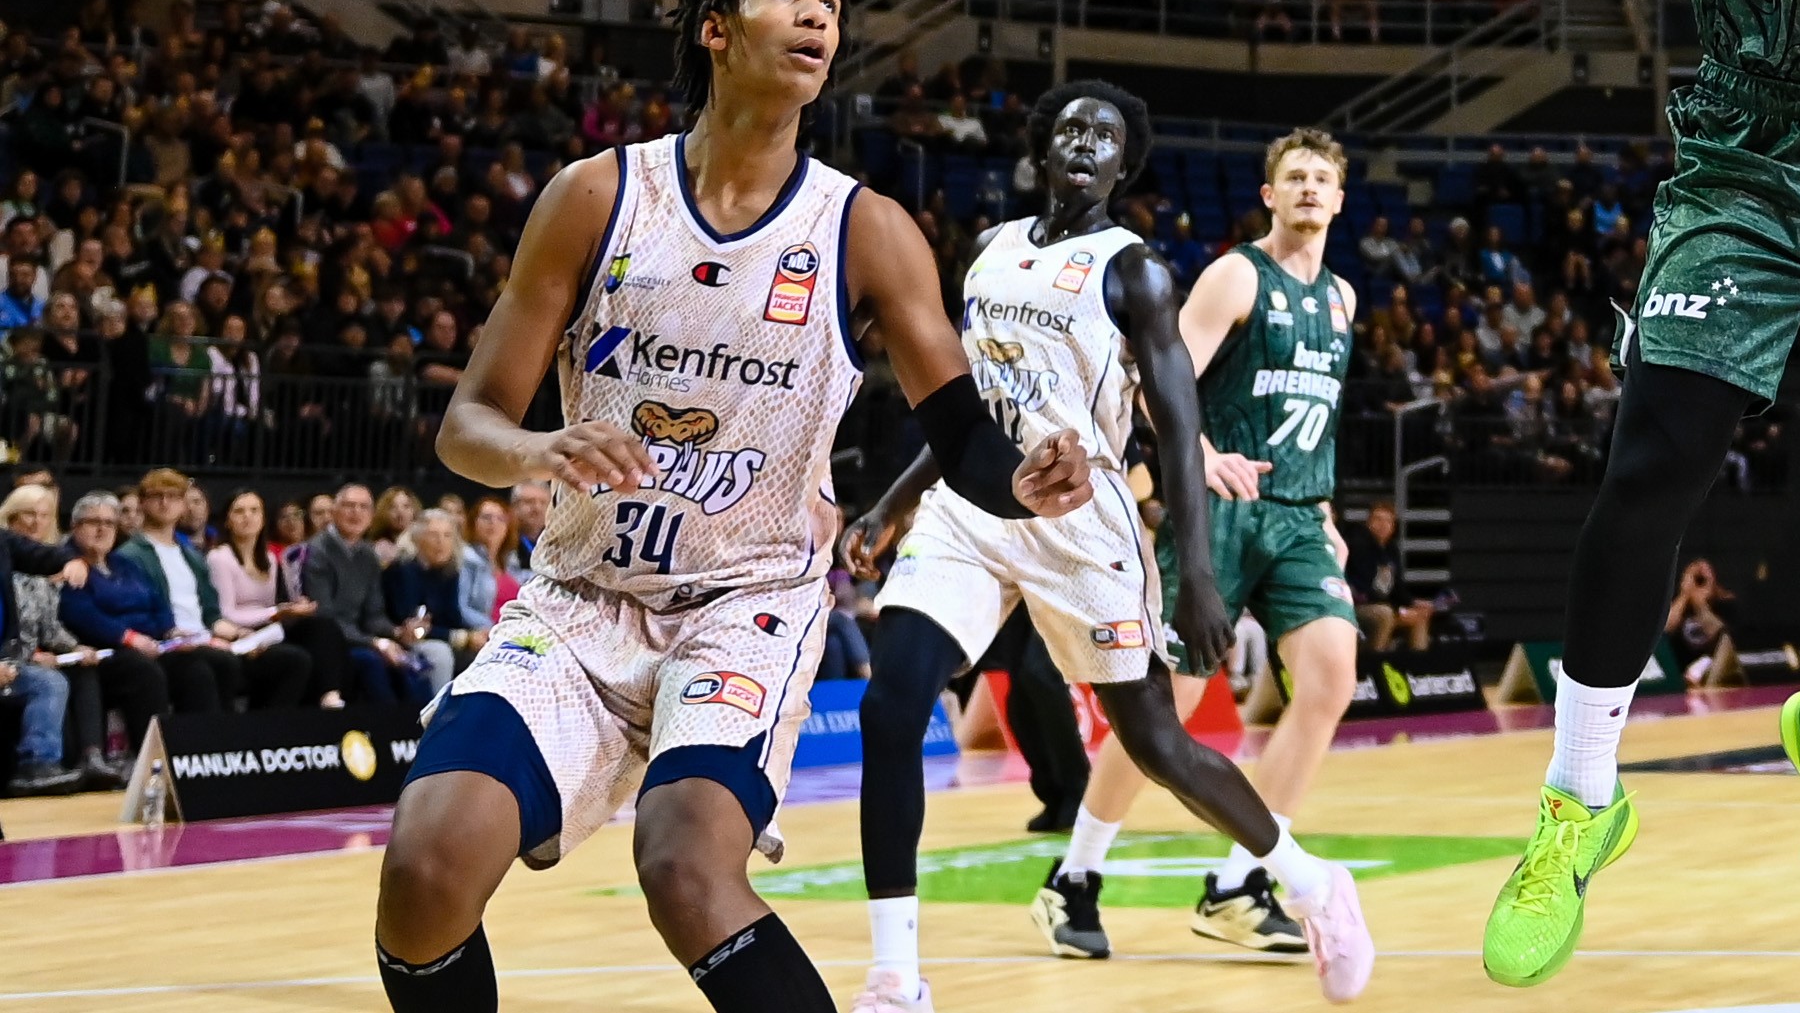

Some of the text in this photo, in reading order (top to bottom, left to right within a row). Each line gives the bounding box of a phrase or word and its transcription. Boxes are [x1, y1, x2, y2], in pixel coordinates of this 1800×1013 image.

[772, 299, 804, 312] JACK'S
[977, 297, 1076, 335] Kenfrost
[1642, 287, 1711, 320] bnz
[631, 331, 800, 390] Kenfrost
[1293, 341, 1333, 372] bnz
[627, 363, 692, 392] Homes
[1266, 399, 1330, 451] 70
[603, 501, 684, 574] 34
[172, 744, 341, 780] MANUKA DOCTOR
